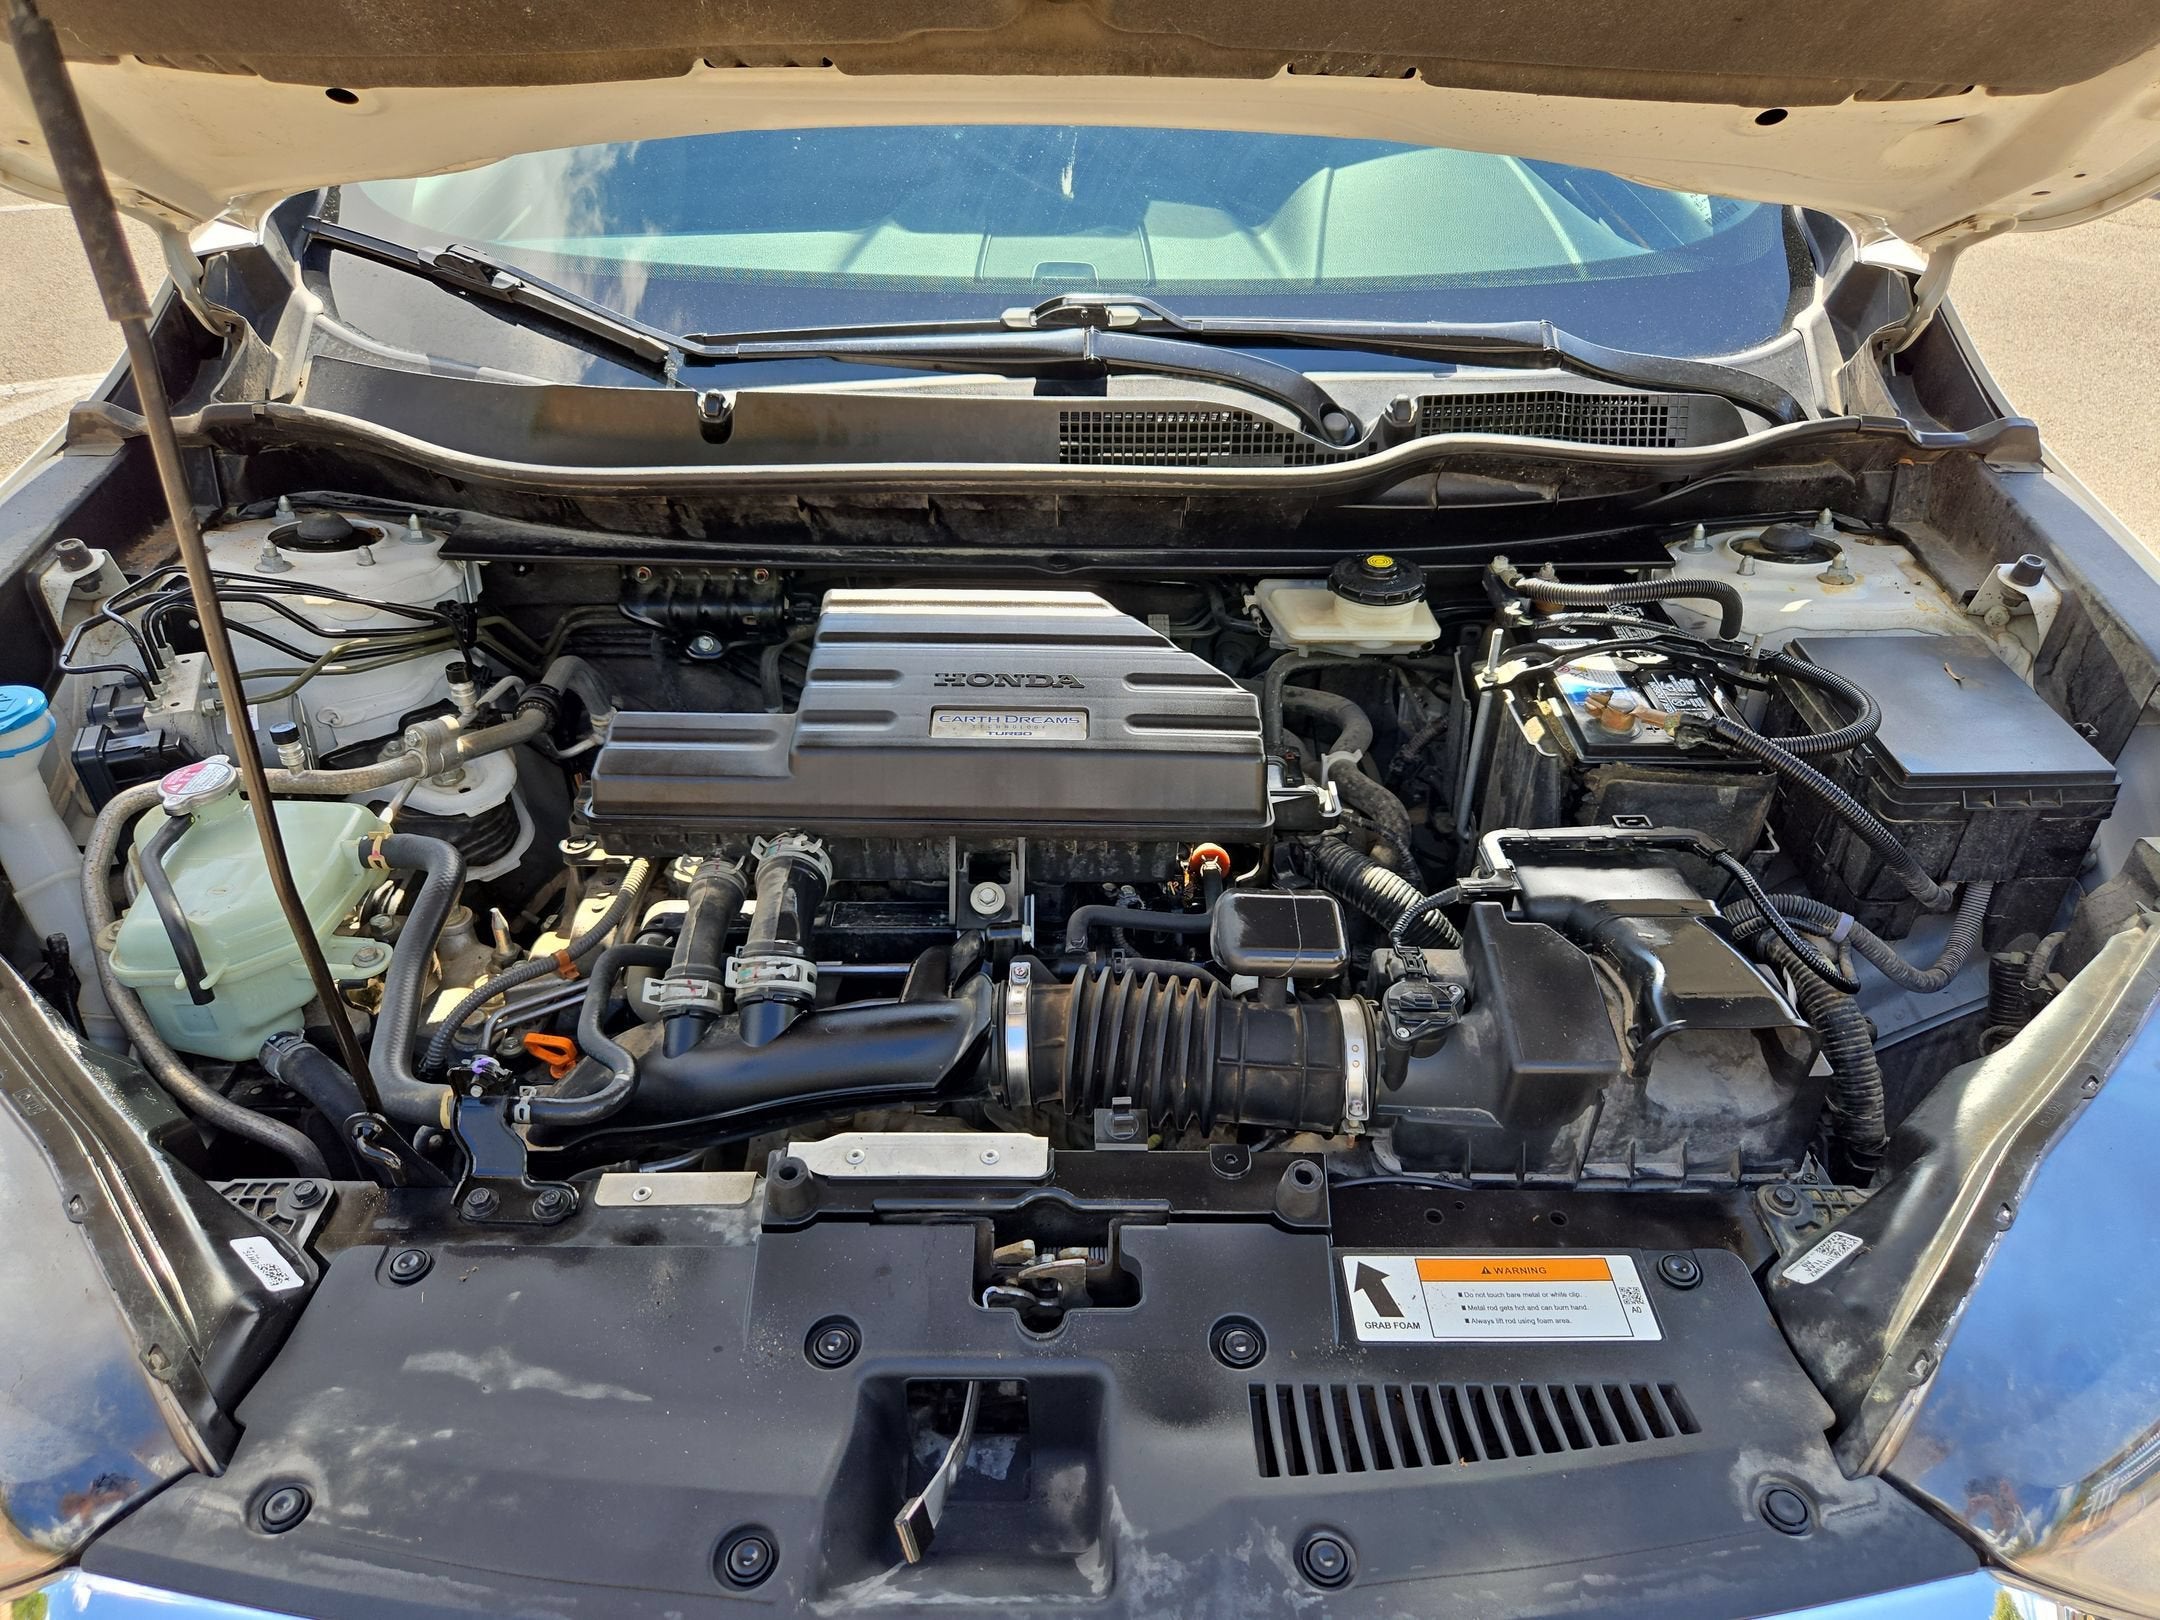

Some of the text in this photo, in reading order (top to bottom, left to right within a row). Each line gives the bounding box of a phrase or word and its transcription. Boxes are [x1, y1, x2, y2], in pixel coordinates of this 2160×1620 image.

[934, 673, 1085, 688] HONDA
[1493, 1266, 1547, 1274] WARNING
[1499, 1304, 1514, 1312] gets
[1364, 1321, 1421, 1329] GRAB FOAM
[1471, 1317, 1495, 1325] Always
[1517, 1317, 1536, 1325] using
